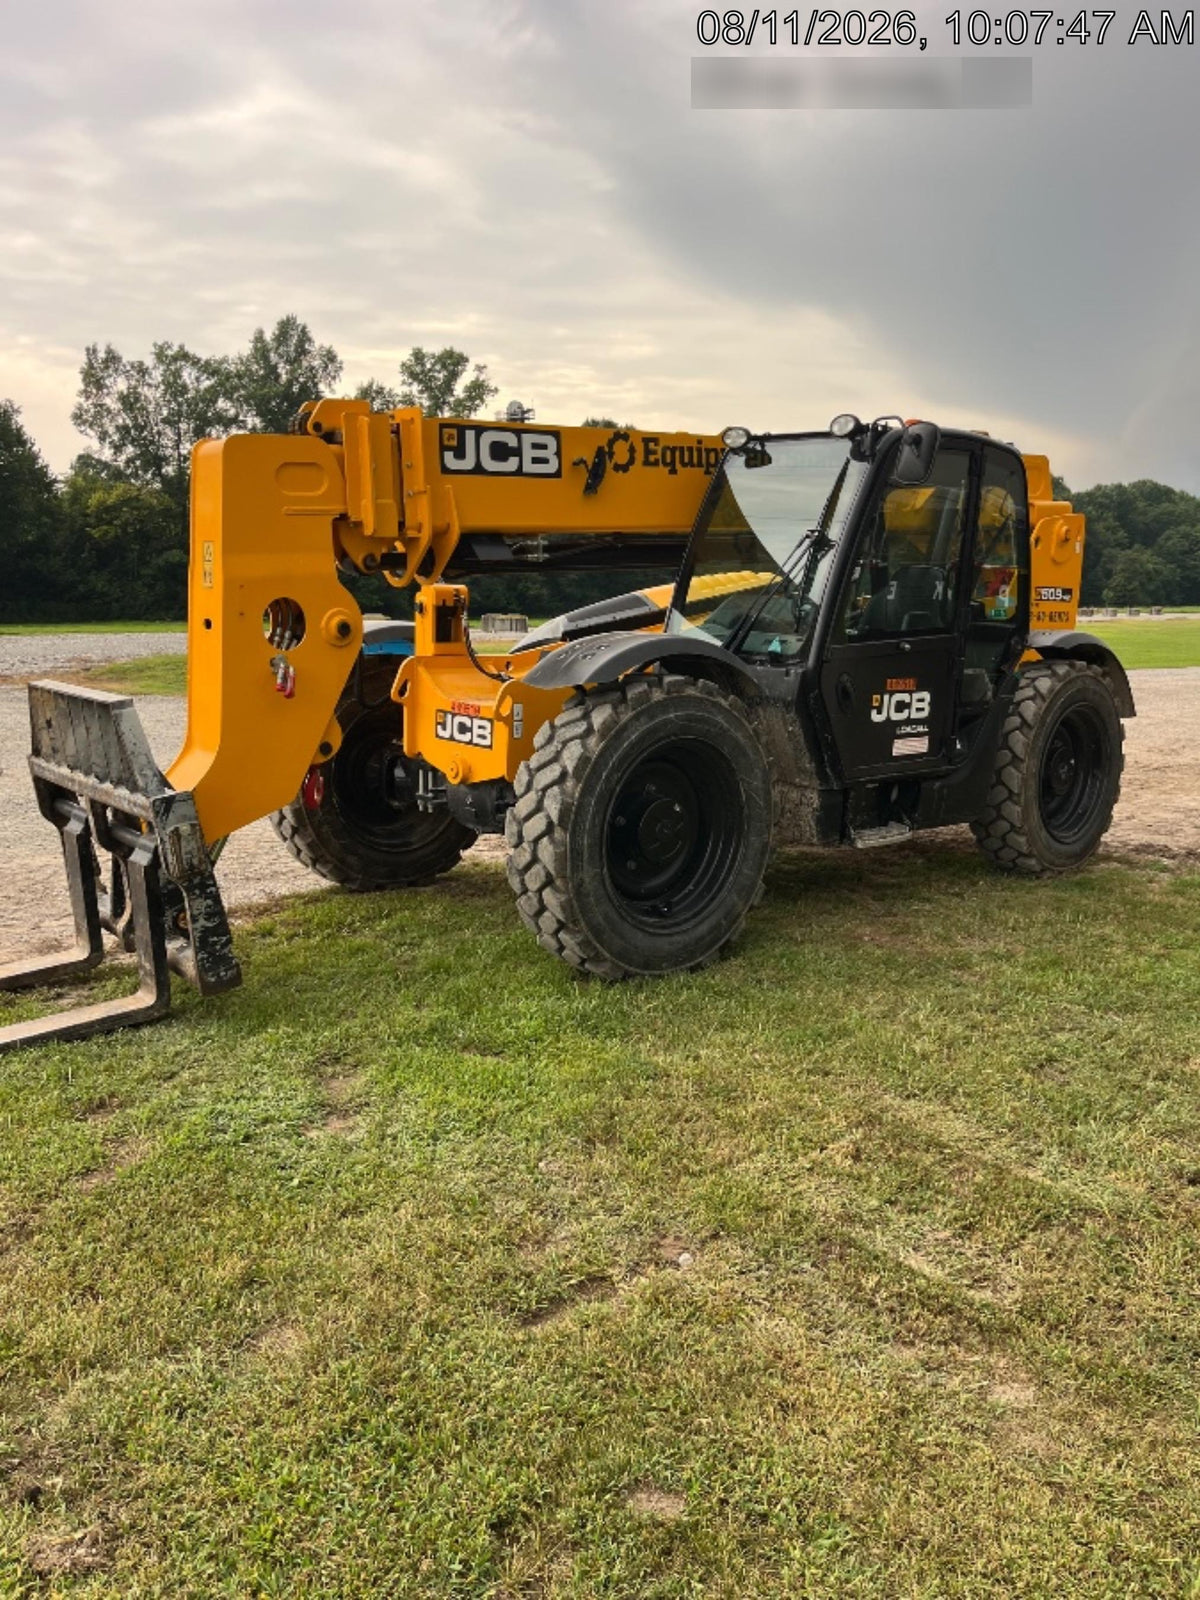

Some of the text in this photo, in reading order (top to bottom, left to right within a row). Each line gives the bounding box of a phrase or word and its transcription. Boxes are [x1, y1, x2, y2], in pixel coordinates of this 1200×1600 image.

[443, 429, 560, 475] JCB
[641, 436, 724, 476] Equip
[870, 691, 931, 723] JCB
[436, 712, 492, 746] JCB
